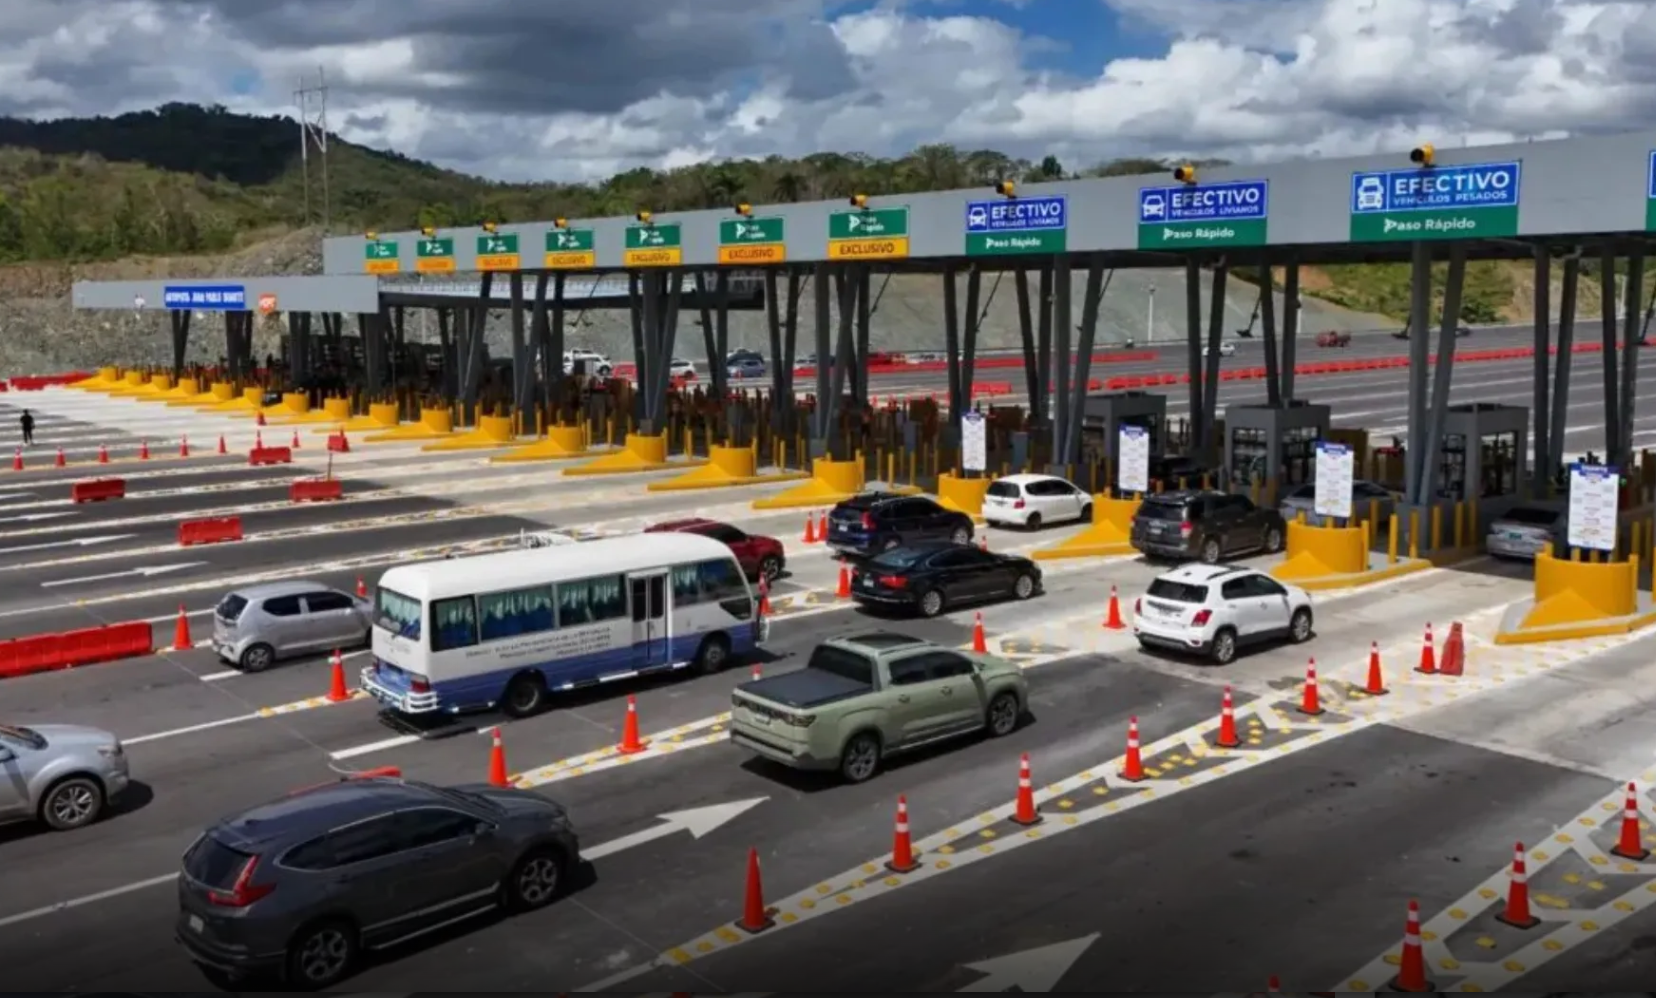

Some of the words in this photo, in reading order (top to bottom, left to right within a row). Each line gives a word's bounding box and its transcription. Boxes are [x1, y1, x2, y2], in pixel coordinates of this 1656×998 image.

[1395, 171, 1509, 195] EFECTIVO
[1172, 189, 1259, 207] EFECTIVO
[1455, 190, 1508, 202] PESADOS
[991, 202, 1061, 219] EFECTIVO
[1219, 204, 1259, 214] LIVIANOS
[1384, 218, 1421, 233] Paso
[1425, 218, 1476, 232] Rápido
[1195, 228, 1235, 240] Rápido
[728, 248, 774, 259] EXCLUSIVO
[839, 242, 895, 255] EXCLUSIVO
